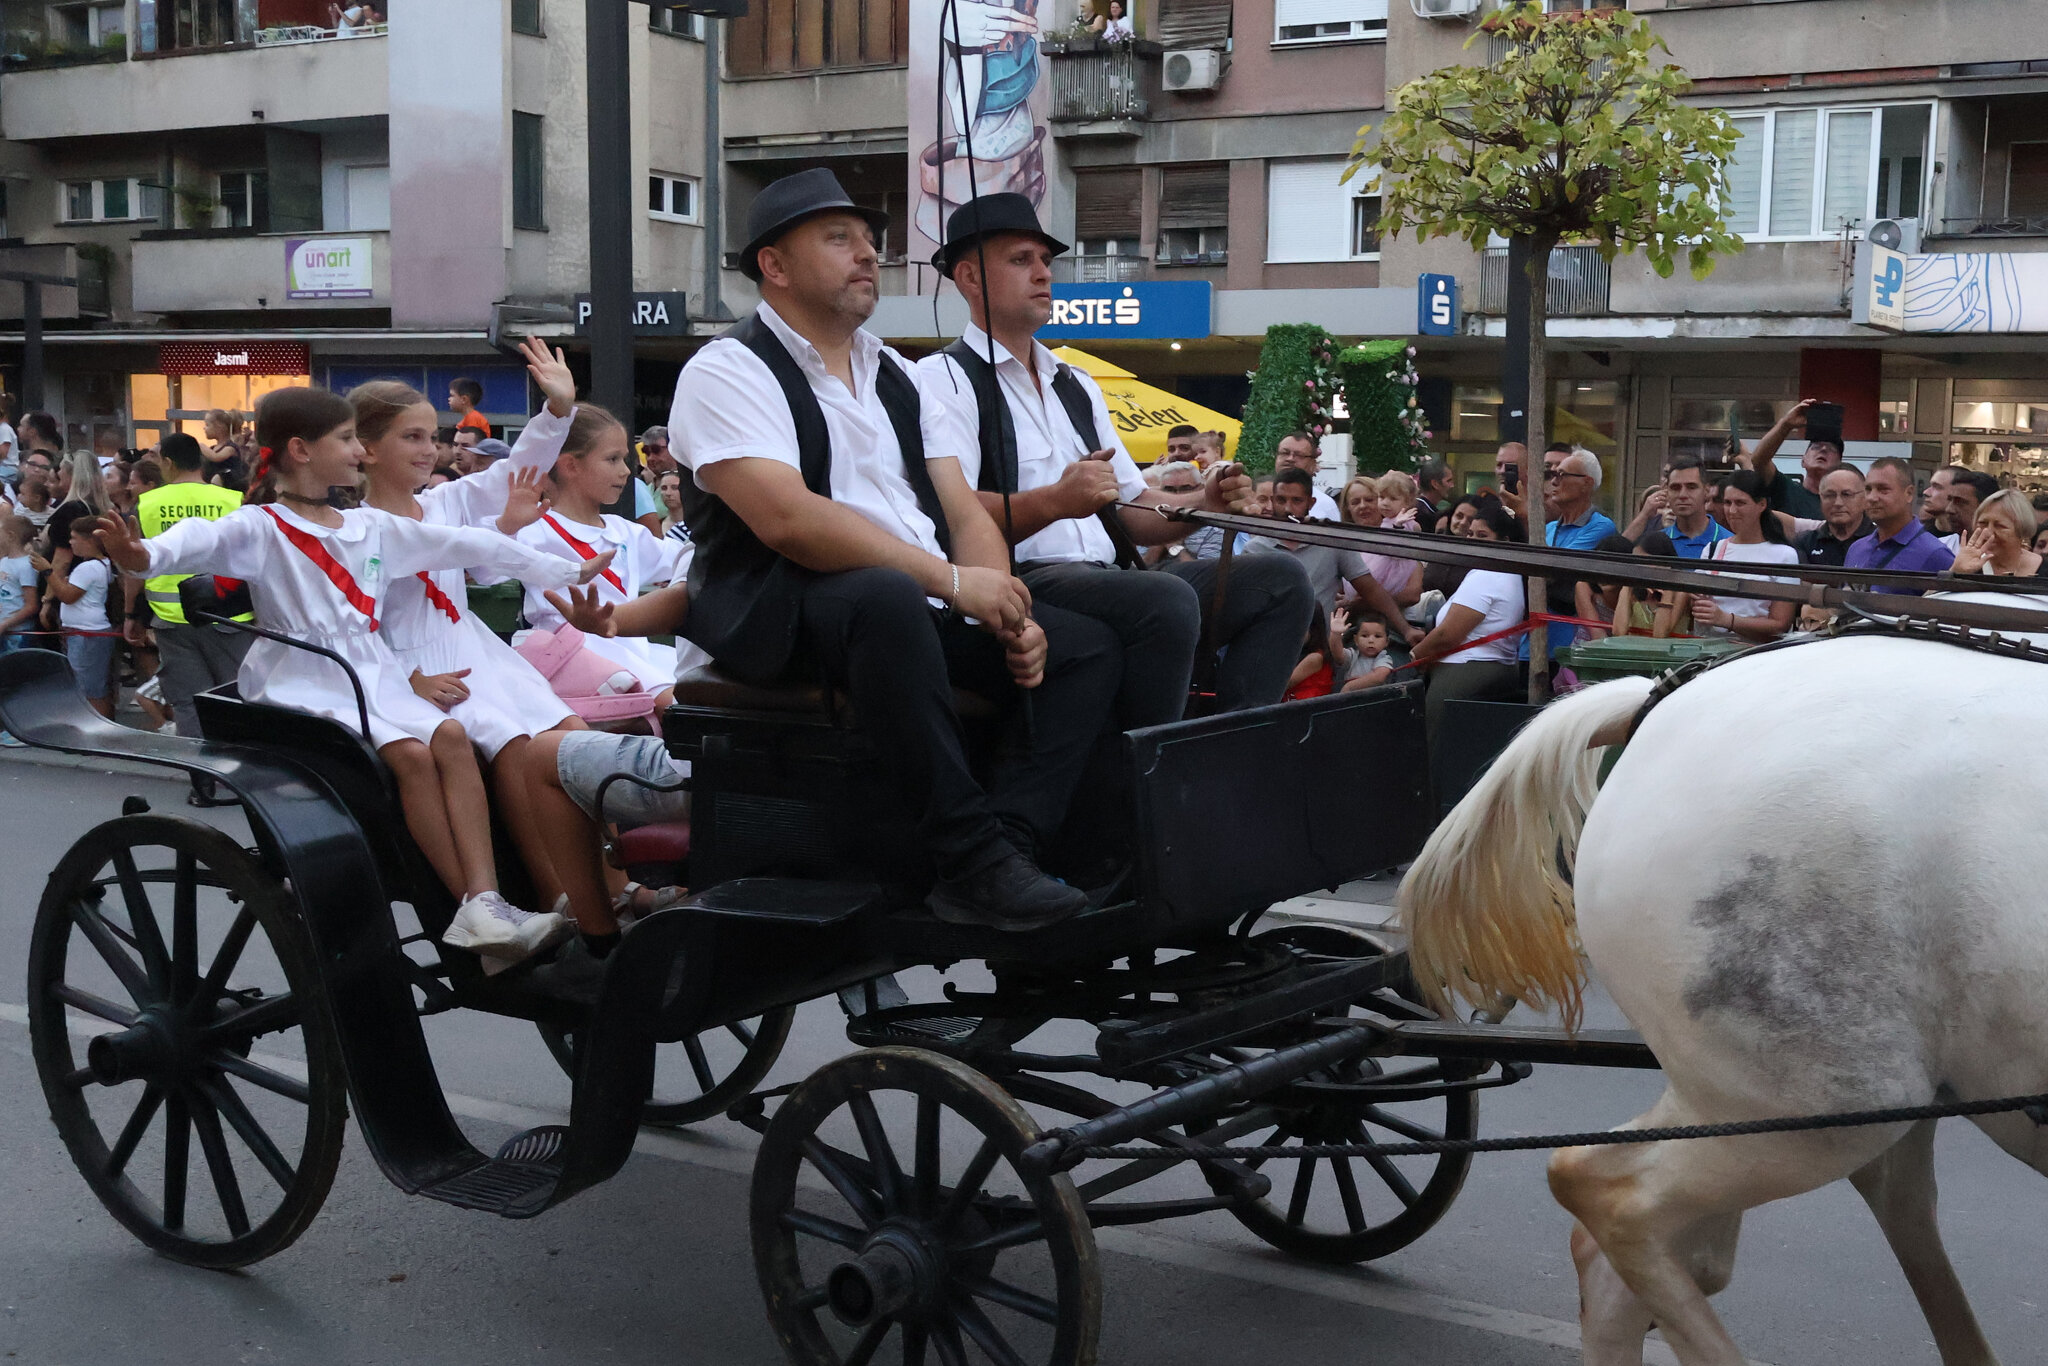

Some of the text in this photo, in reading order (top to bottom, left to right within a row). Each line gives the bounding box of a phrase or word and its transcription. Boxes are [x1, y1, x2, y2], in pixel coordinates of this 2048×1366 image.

[305, 247, 351, 268] unart
[214, 352, 249, 366] Jasmil
[1108, 407, 1189, 432] Jelen
[160, 505, 223, 518] SECURITY
